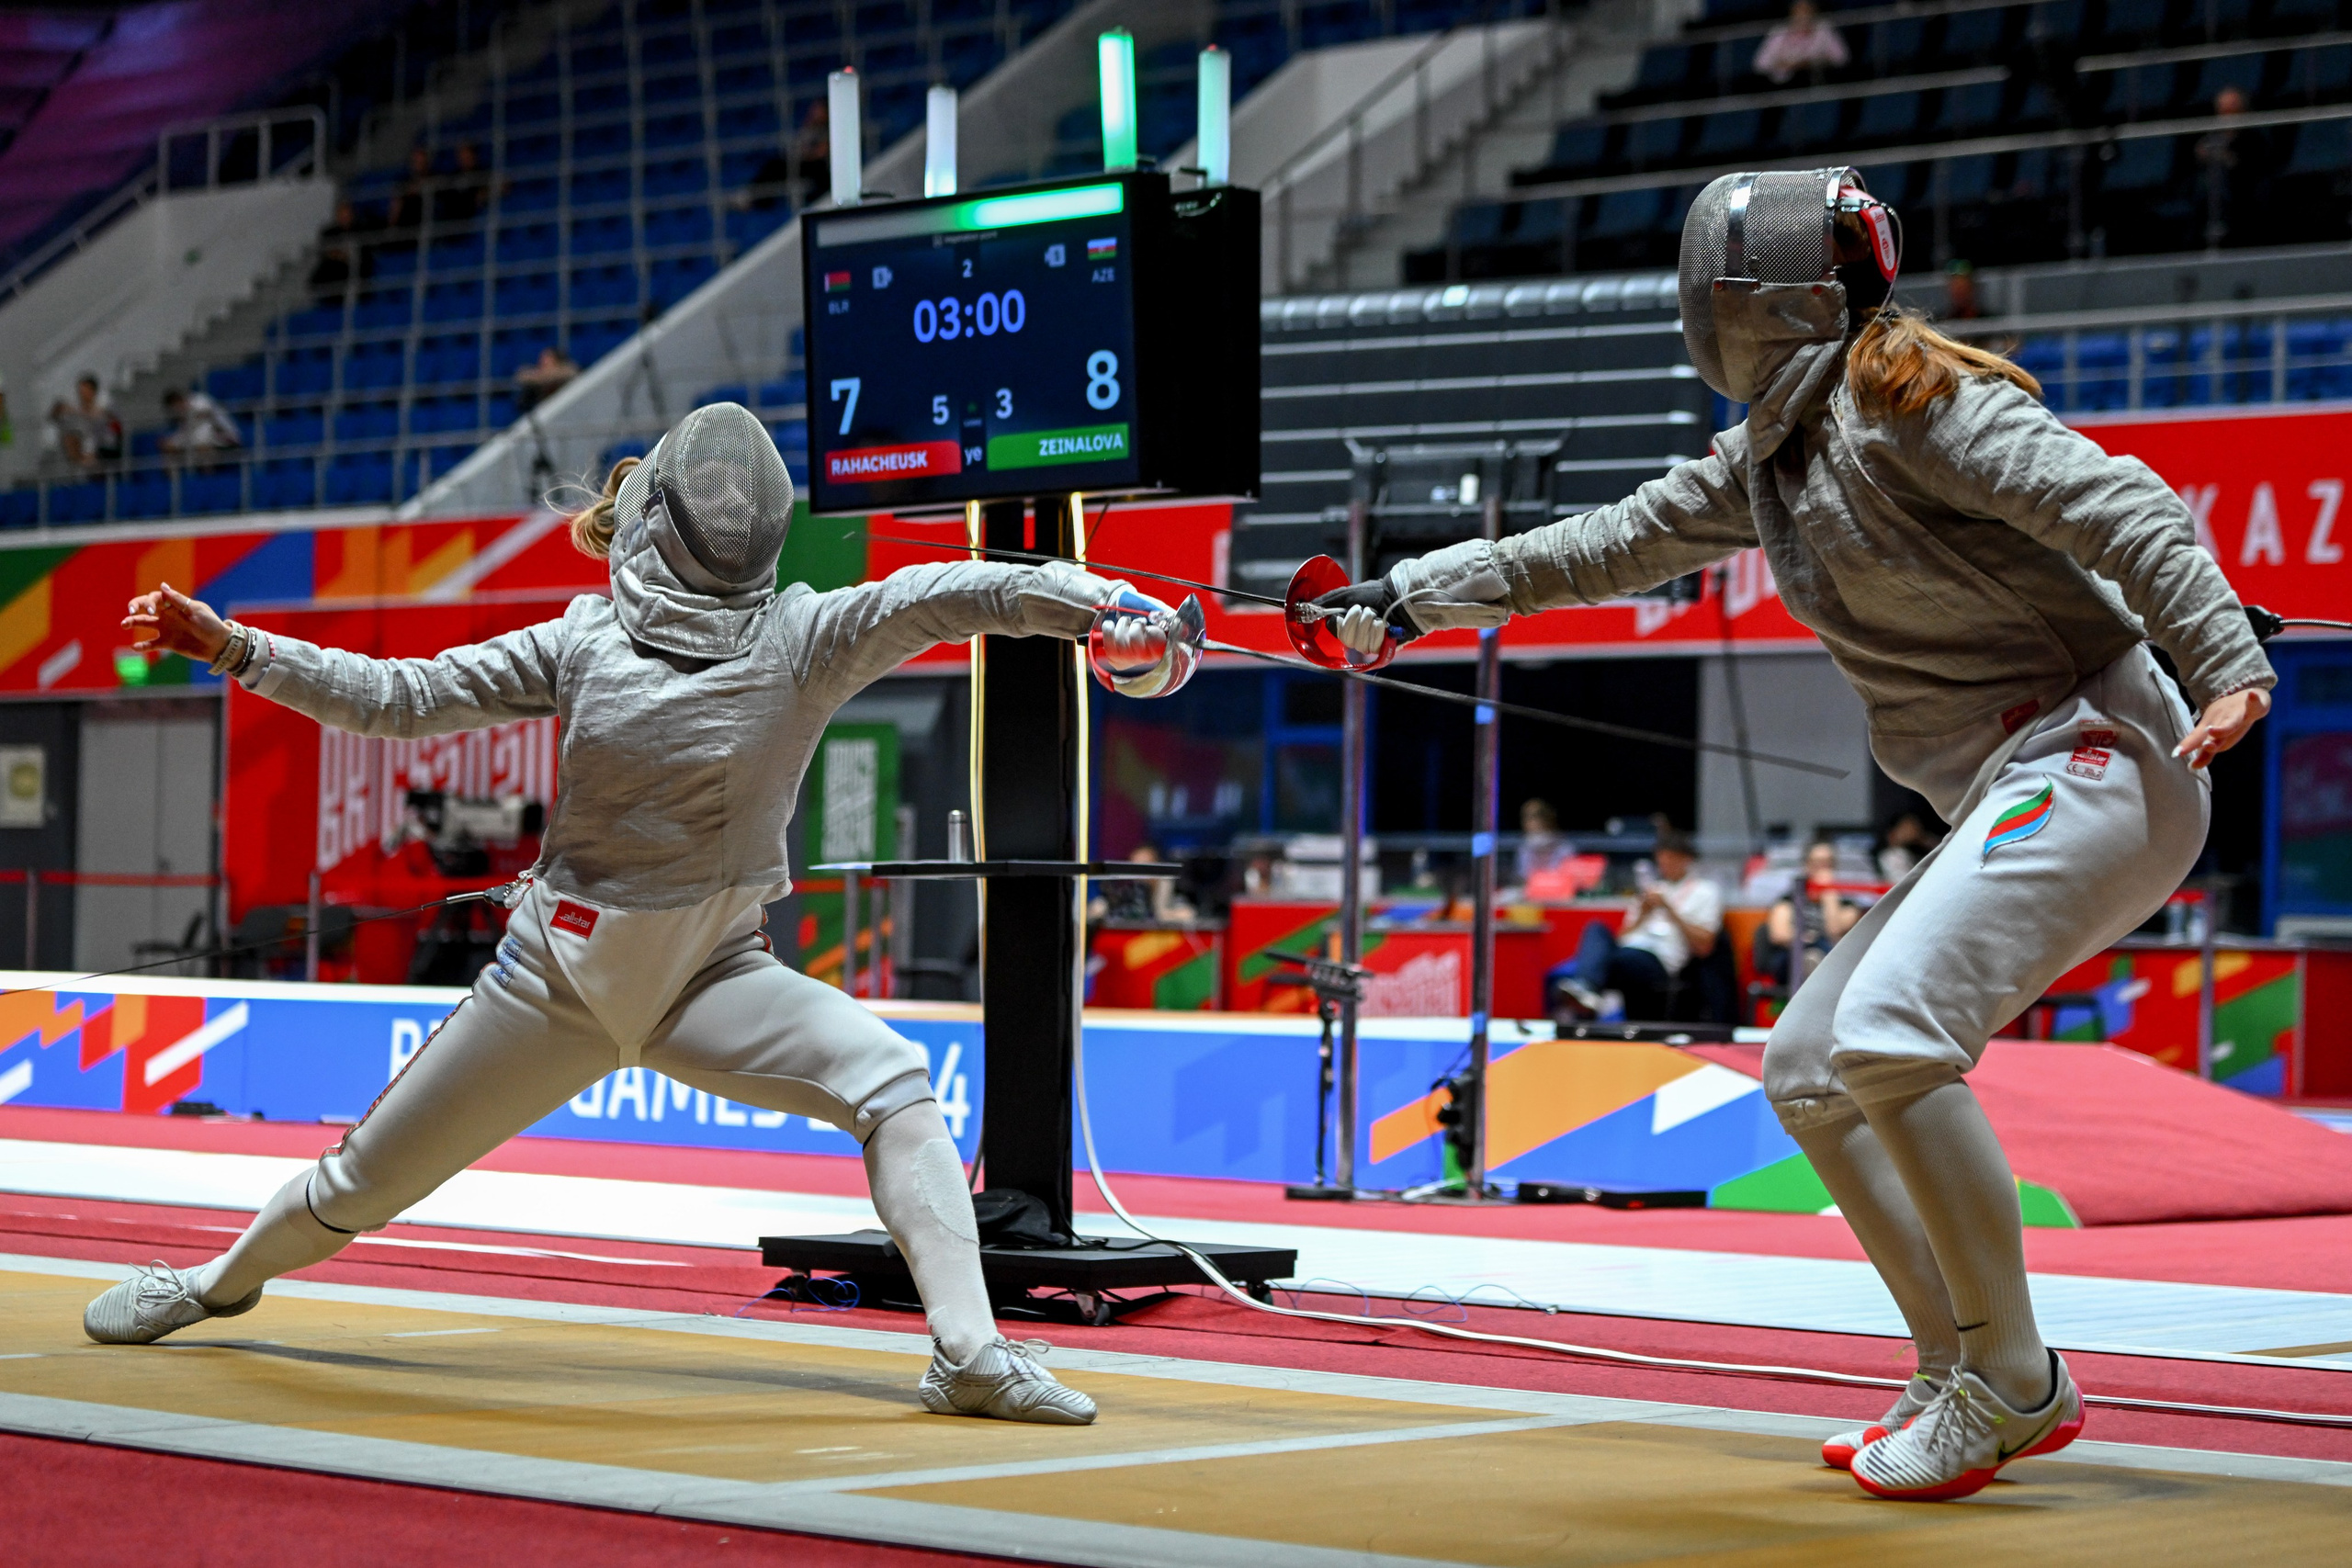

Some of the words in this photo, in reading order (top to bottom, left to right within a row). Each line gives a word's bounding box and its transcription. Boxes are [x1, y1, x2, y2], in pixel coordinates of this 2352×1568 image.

[913, 288, 1026, 344] 03:00
[1086, 349, 1121, 411] 8
[831, 378, 862, 436] 7
[933, 394, 950, 425] 5
[995, 388, 1013, 420] 3
[1038, 432, 1124, 457] ZEINALOVA
[831, 450, 928, 476] RAHACHEUSK
[562, 911, 591, 929] allstar
[570, 1066, 787, 1129] GAM
